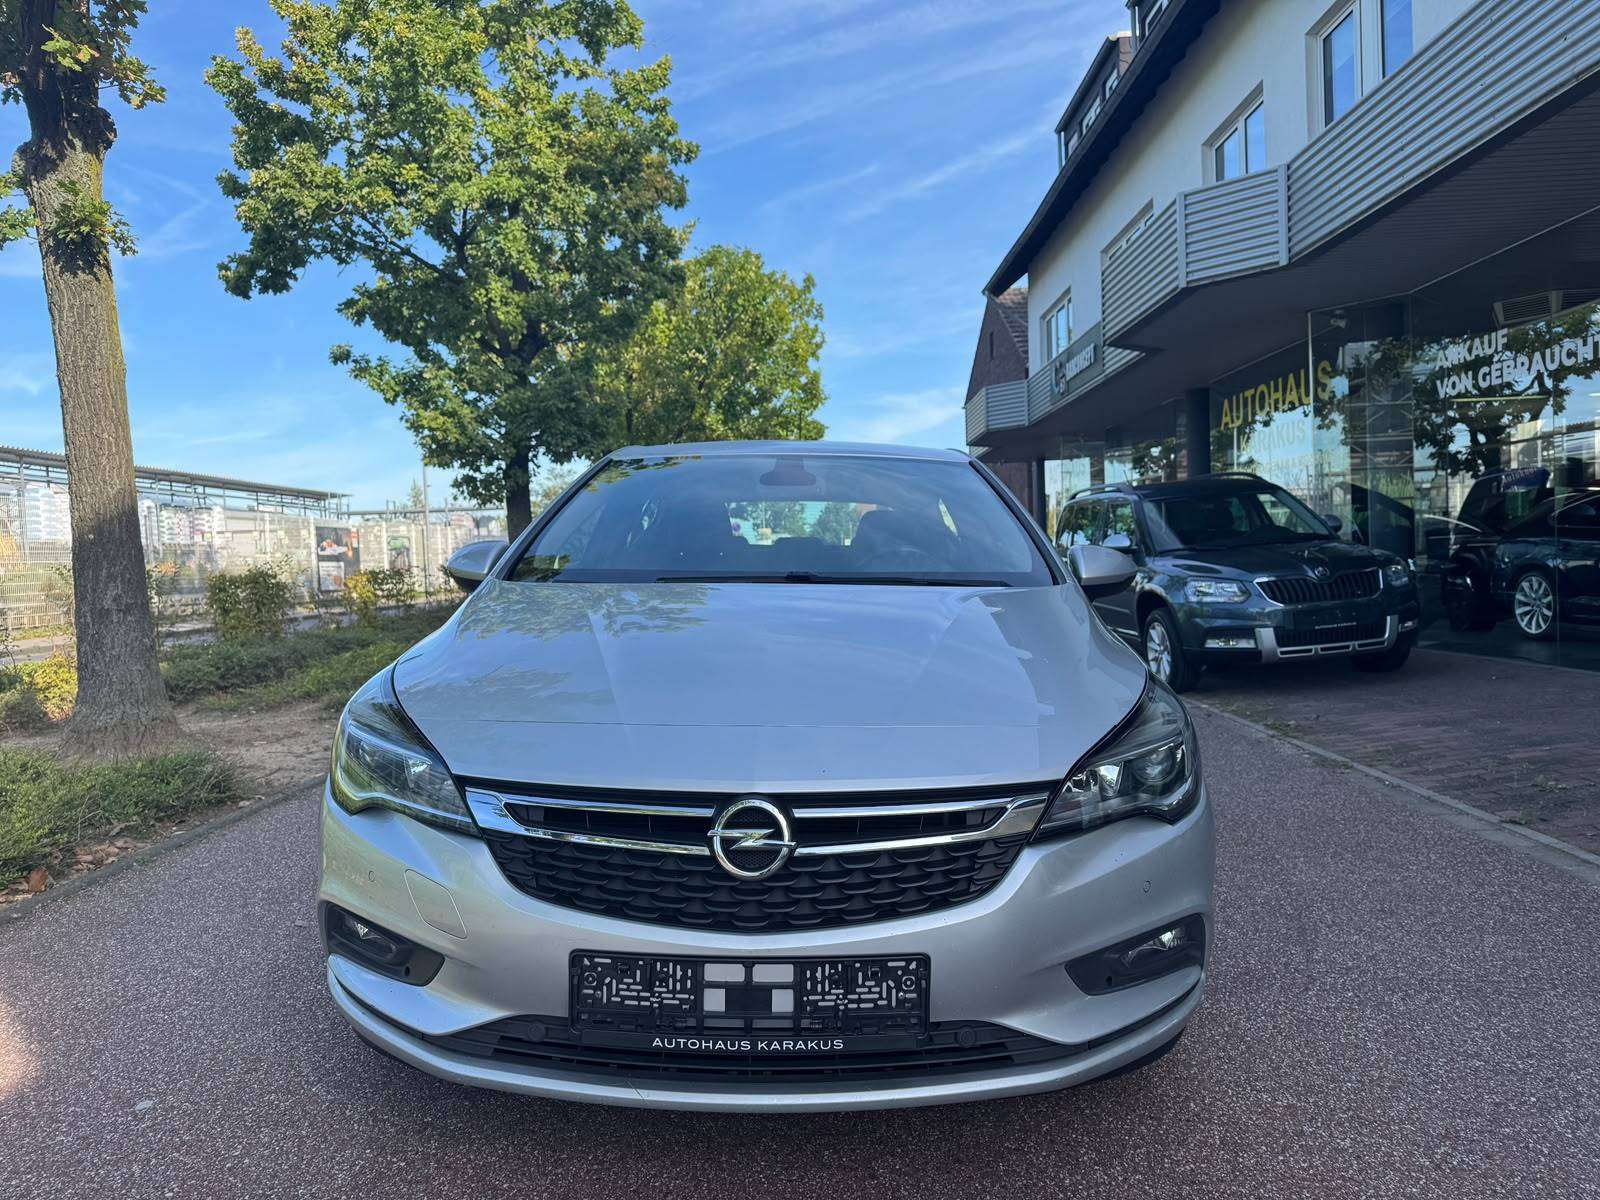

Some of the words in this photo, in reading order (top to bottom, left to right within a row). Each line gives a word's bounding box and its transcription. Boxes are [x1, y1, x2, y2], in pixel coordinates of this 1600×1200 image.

[1435, 328, 1508, 371] ANKAUF
[1220, 360, 1333, 431] AUTOHAUS
[1436, 371, 1473, 399] VON
[1239, 419, 1306, 453] KARAKUS
[652, 1037, 751, 1051] AUTOHAUS
[757, 1038, 845, 1051] KARAKUS
